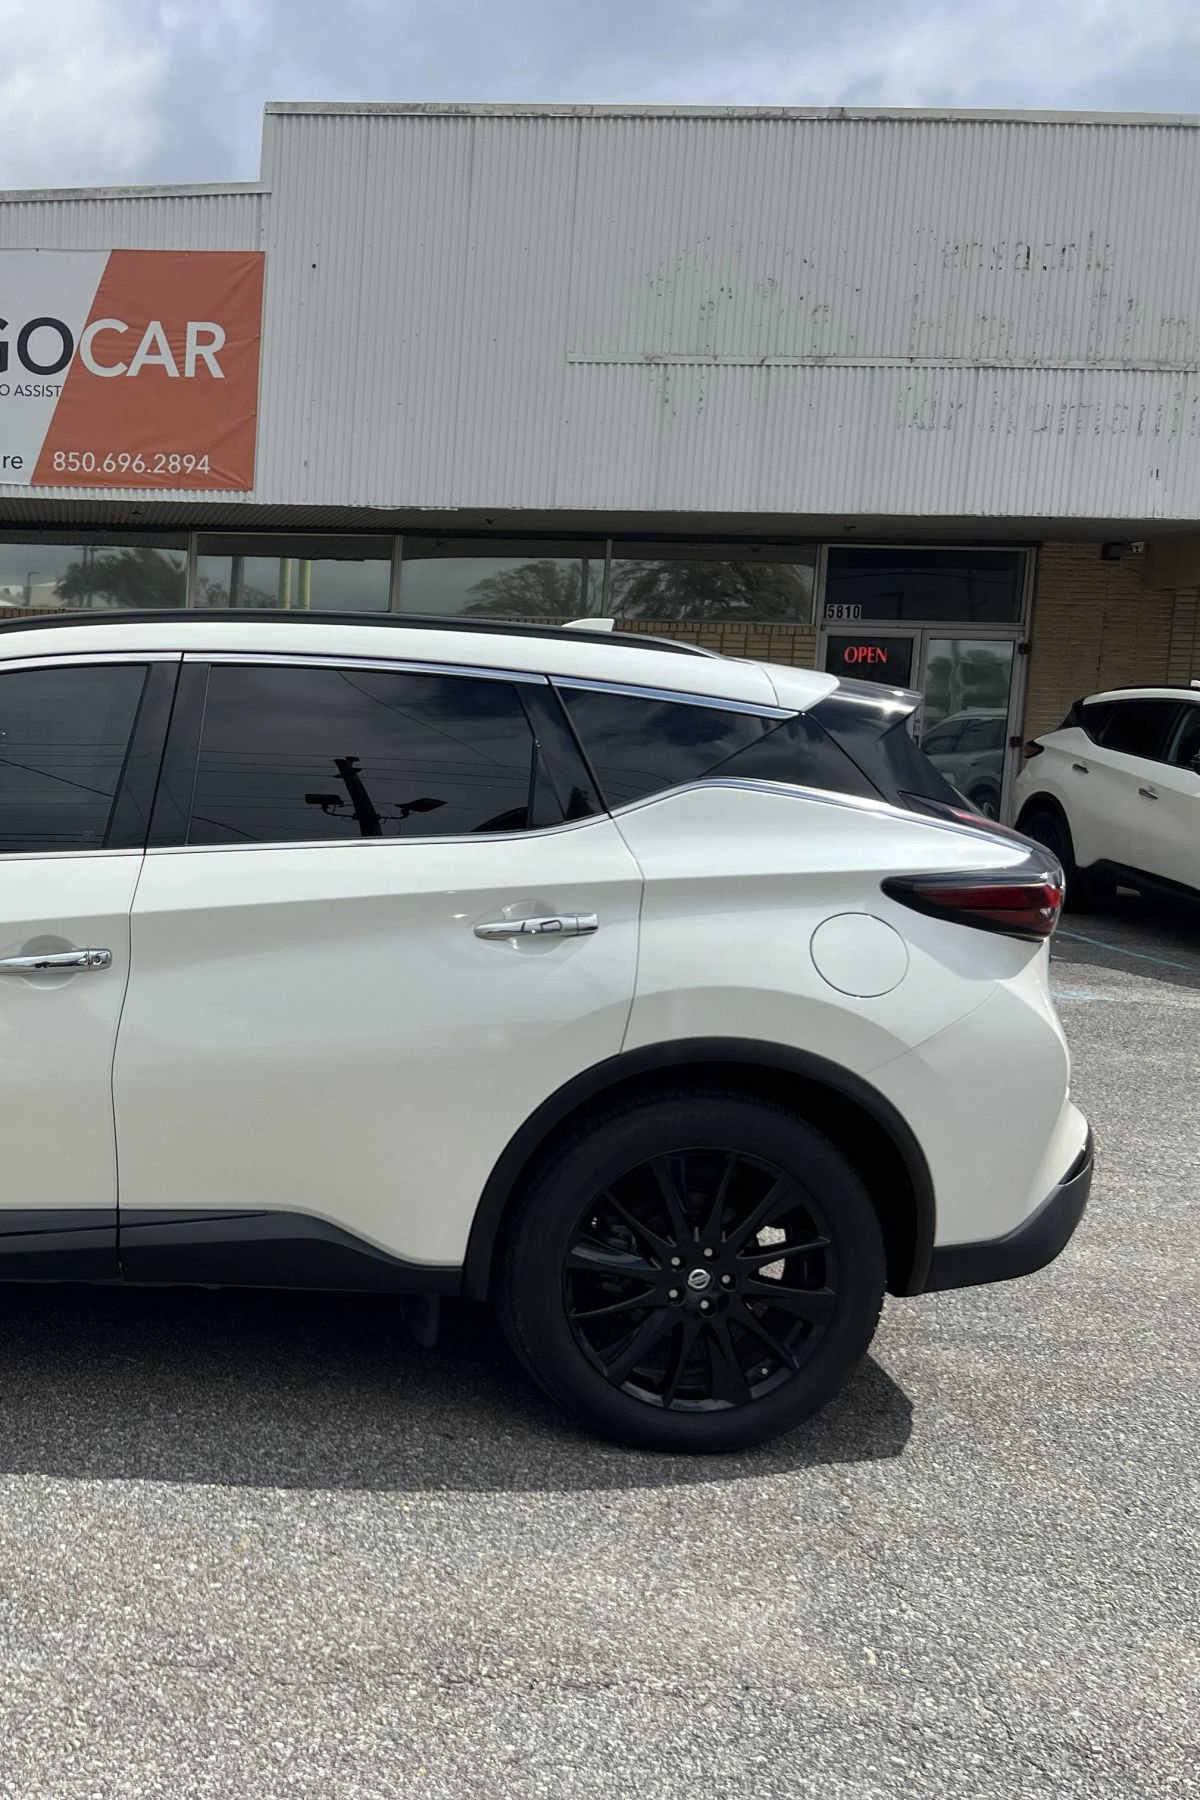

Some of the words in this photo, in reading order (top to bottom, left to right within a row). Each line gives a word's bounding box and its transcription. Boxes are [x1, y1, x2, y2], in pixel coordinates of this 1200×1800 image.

[13, 384, 62, 398] ASSIST
[53, 451, 211, 474] 850.696.2894
[827, 604, 860, 619] 5810
[843, 646, 888, 664] OPEN
